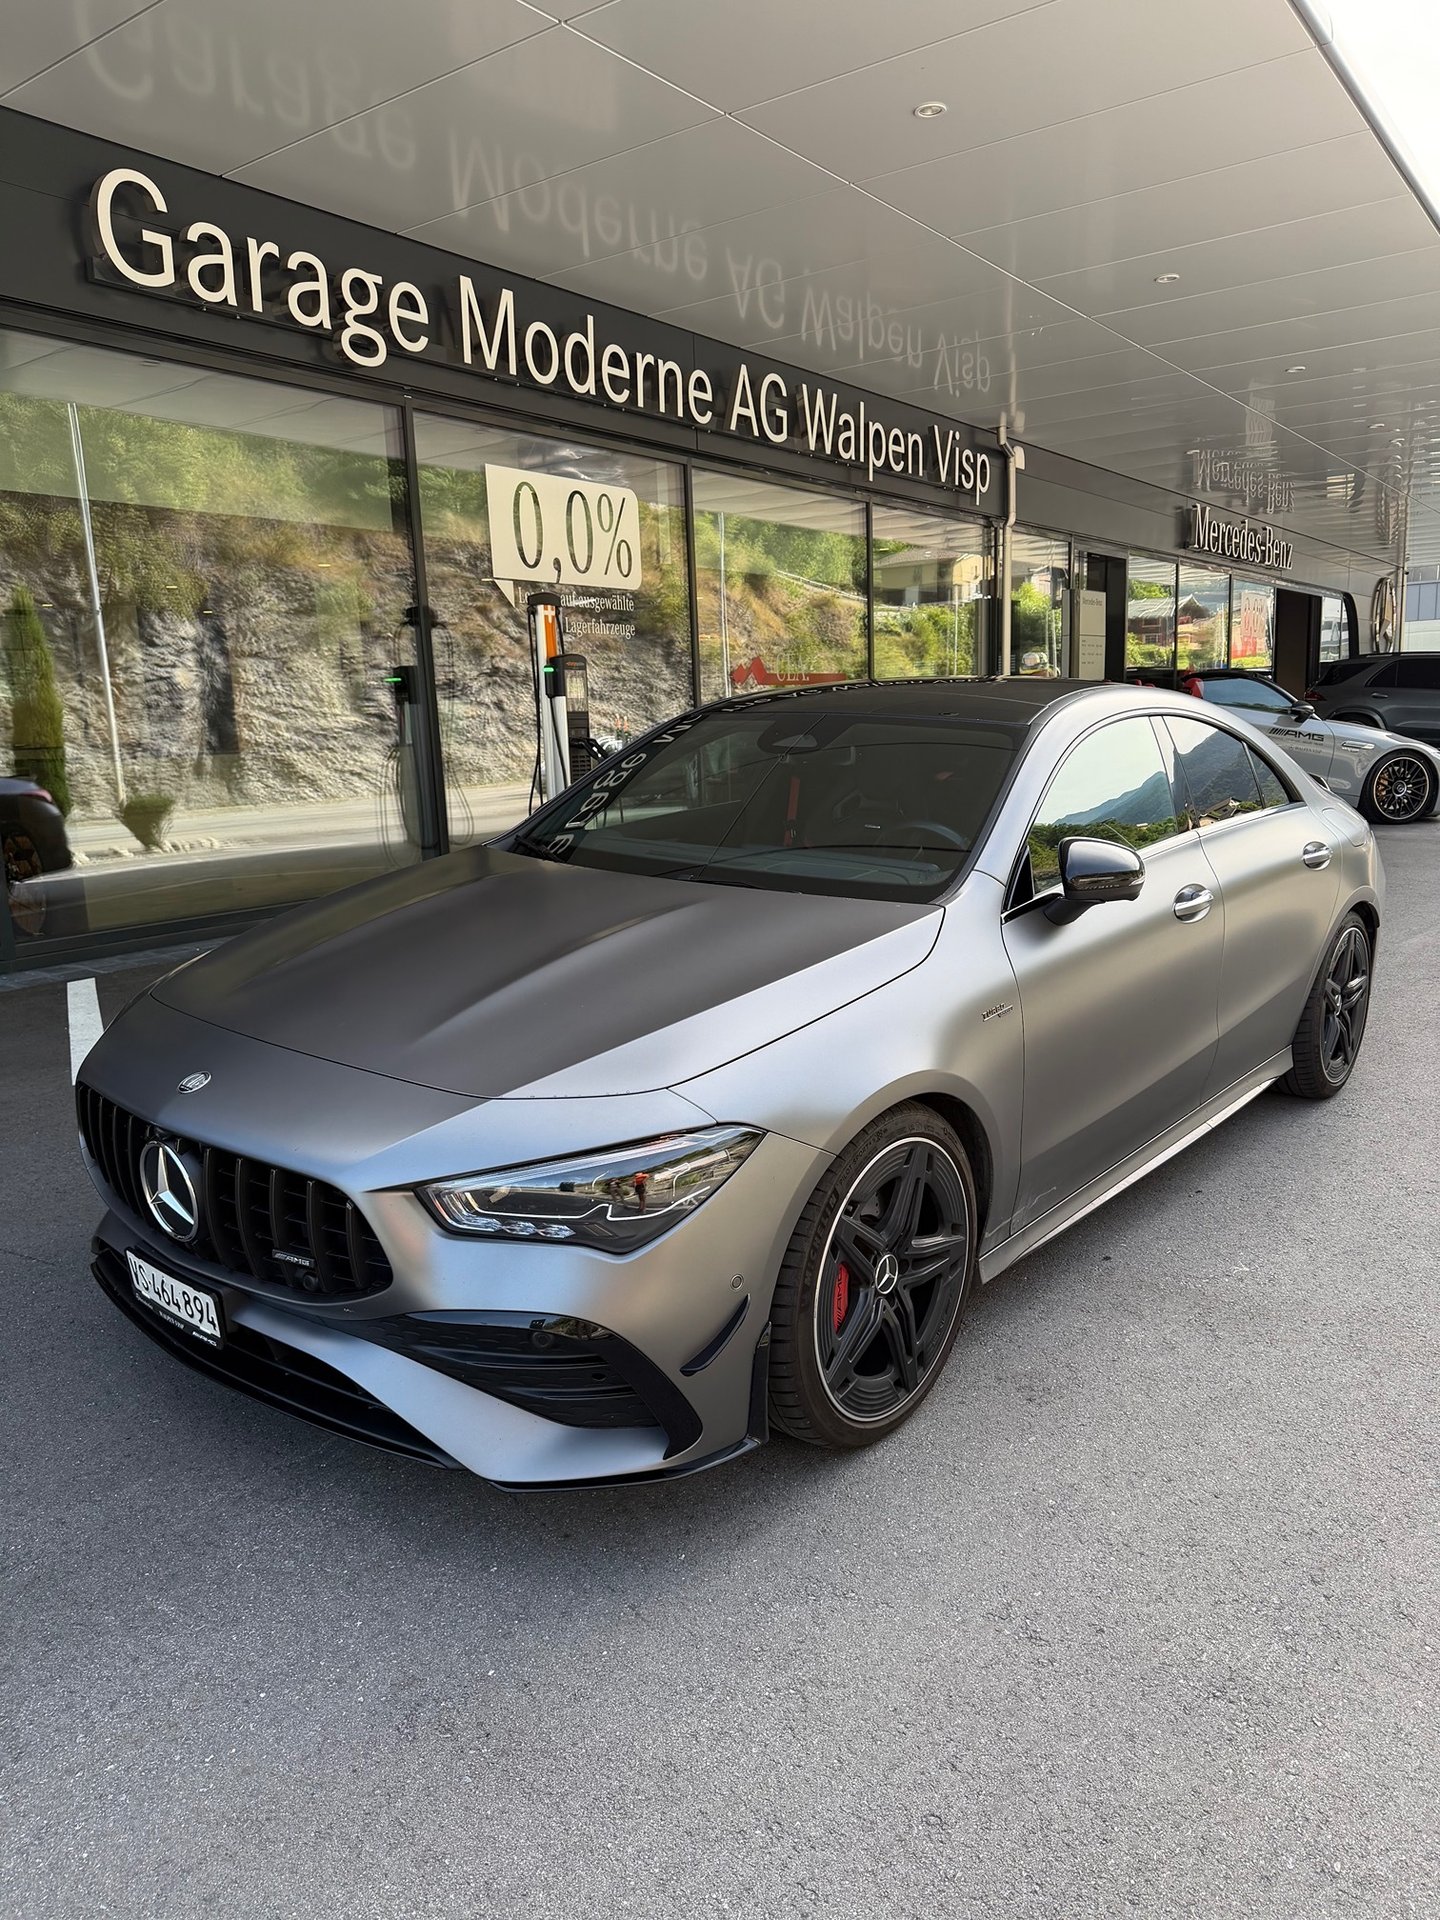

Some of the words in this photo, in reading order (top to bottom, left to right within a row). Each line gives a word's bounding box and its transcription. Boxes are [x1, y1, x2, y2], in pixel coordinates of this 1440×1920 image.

[96, 167, 430, 368] Garage
[459, 275, 714, 425] Moderne
[730, 363, 788, 443] AG
[802, 383, 924, 482] Walpen
[933, 424, 990, 506] Visp
[513, 481, 633, 585] 0,0%
[1193, 503, 1294, 570] Mercedes-Benz
[560, 591, 577, 607] auf
[579, 593, 635, 613] ausgewählte
[565, 617, 636, 640] Lagerfahrzeuge
[1284, 728, 1325, 742] AMG
